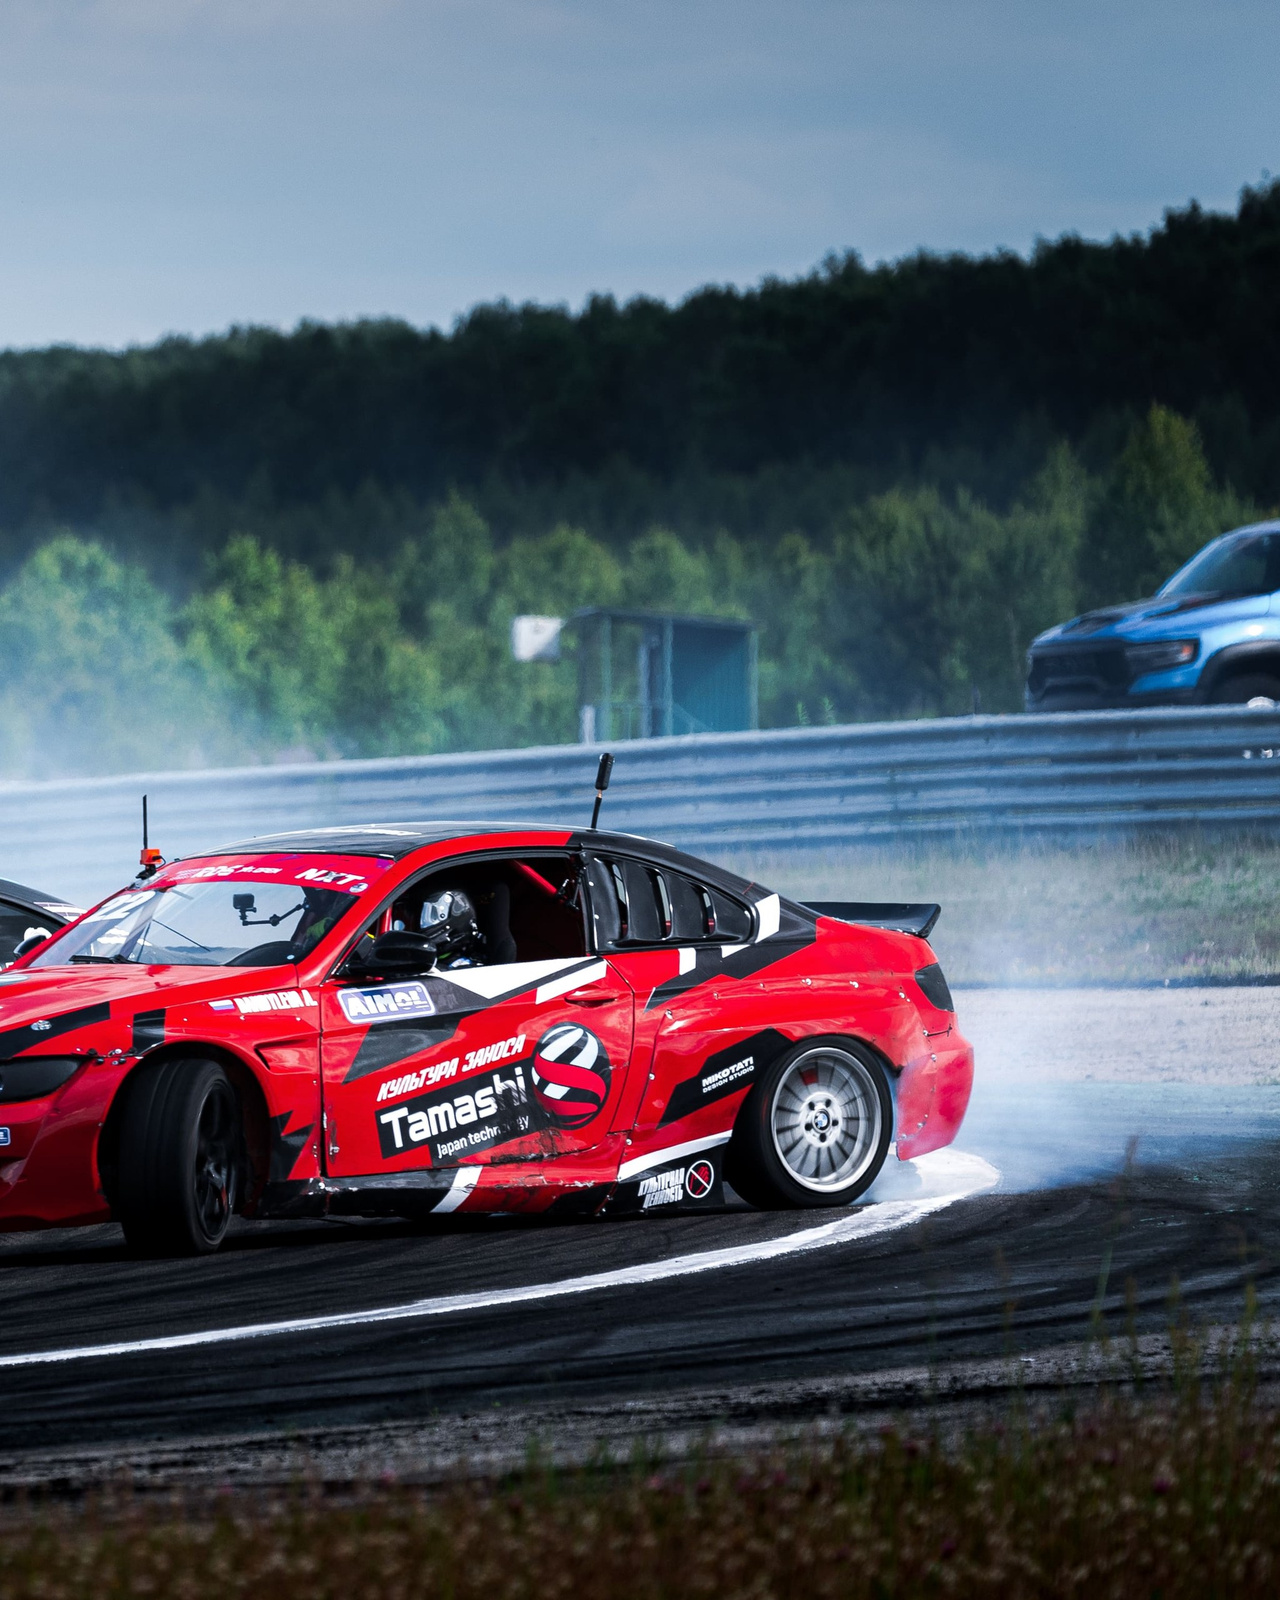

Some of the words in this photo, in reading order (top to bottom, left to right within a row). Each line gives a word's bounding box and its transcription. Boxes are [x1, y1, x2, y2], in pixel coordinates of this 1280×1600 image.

[294, 868, 365, 885] NXT
[347, 990, 429, 1017] AIMOL
[376, 1057, 460, 1102] КУЛЬТУРА
[461, 1034, 526, 1073] ЗАНОСА
[702, 1056, 754, 1087] MIKOTATI
[702, 1078, 728, 1093] DESIGN
[729, 1065, 754, 1081] STUDIO
[437, 1137, 468, 1159] Japan
